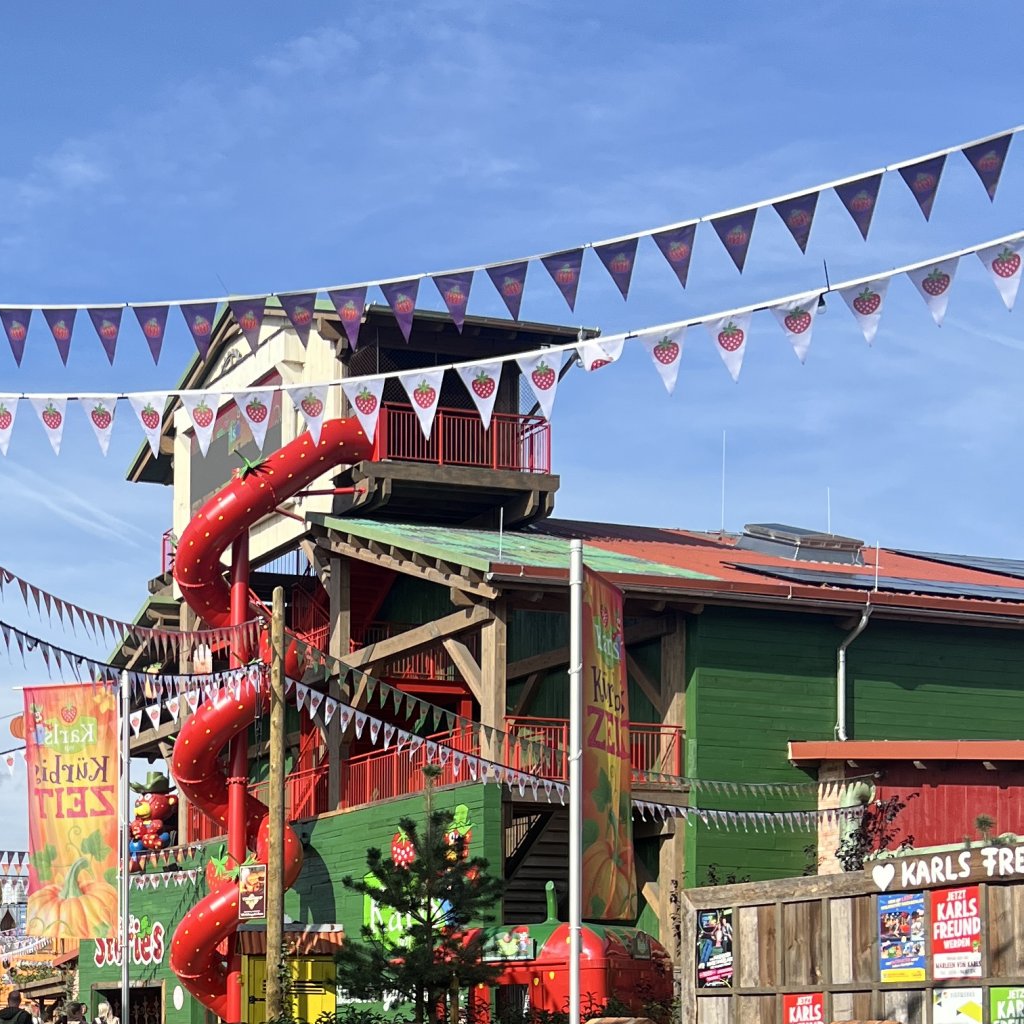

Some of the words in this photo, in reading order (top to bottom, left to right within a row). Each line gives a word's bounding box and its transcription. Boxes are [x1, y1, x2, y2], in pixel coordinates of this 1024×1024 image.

[901, 851, 971, 887] KARLS
[946, 890, 966, 901] JETZT
[937, 898, 977, 921] KARLS
[933, 917, 981, 940] FREUND
[943, 938, 971, 949] WERDEN
[796, 996, 813, 1005] JETZT
[997, 999, 1024, 1019] KAR
[789, 1005, 821, 1023] KARLS
